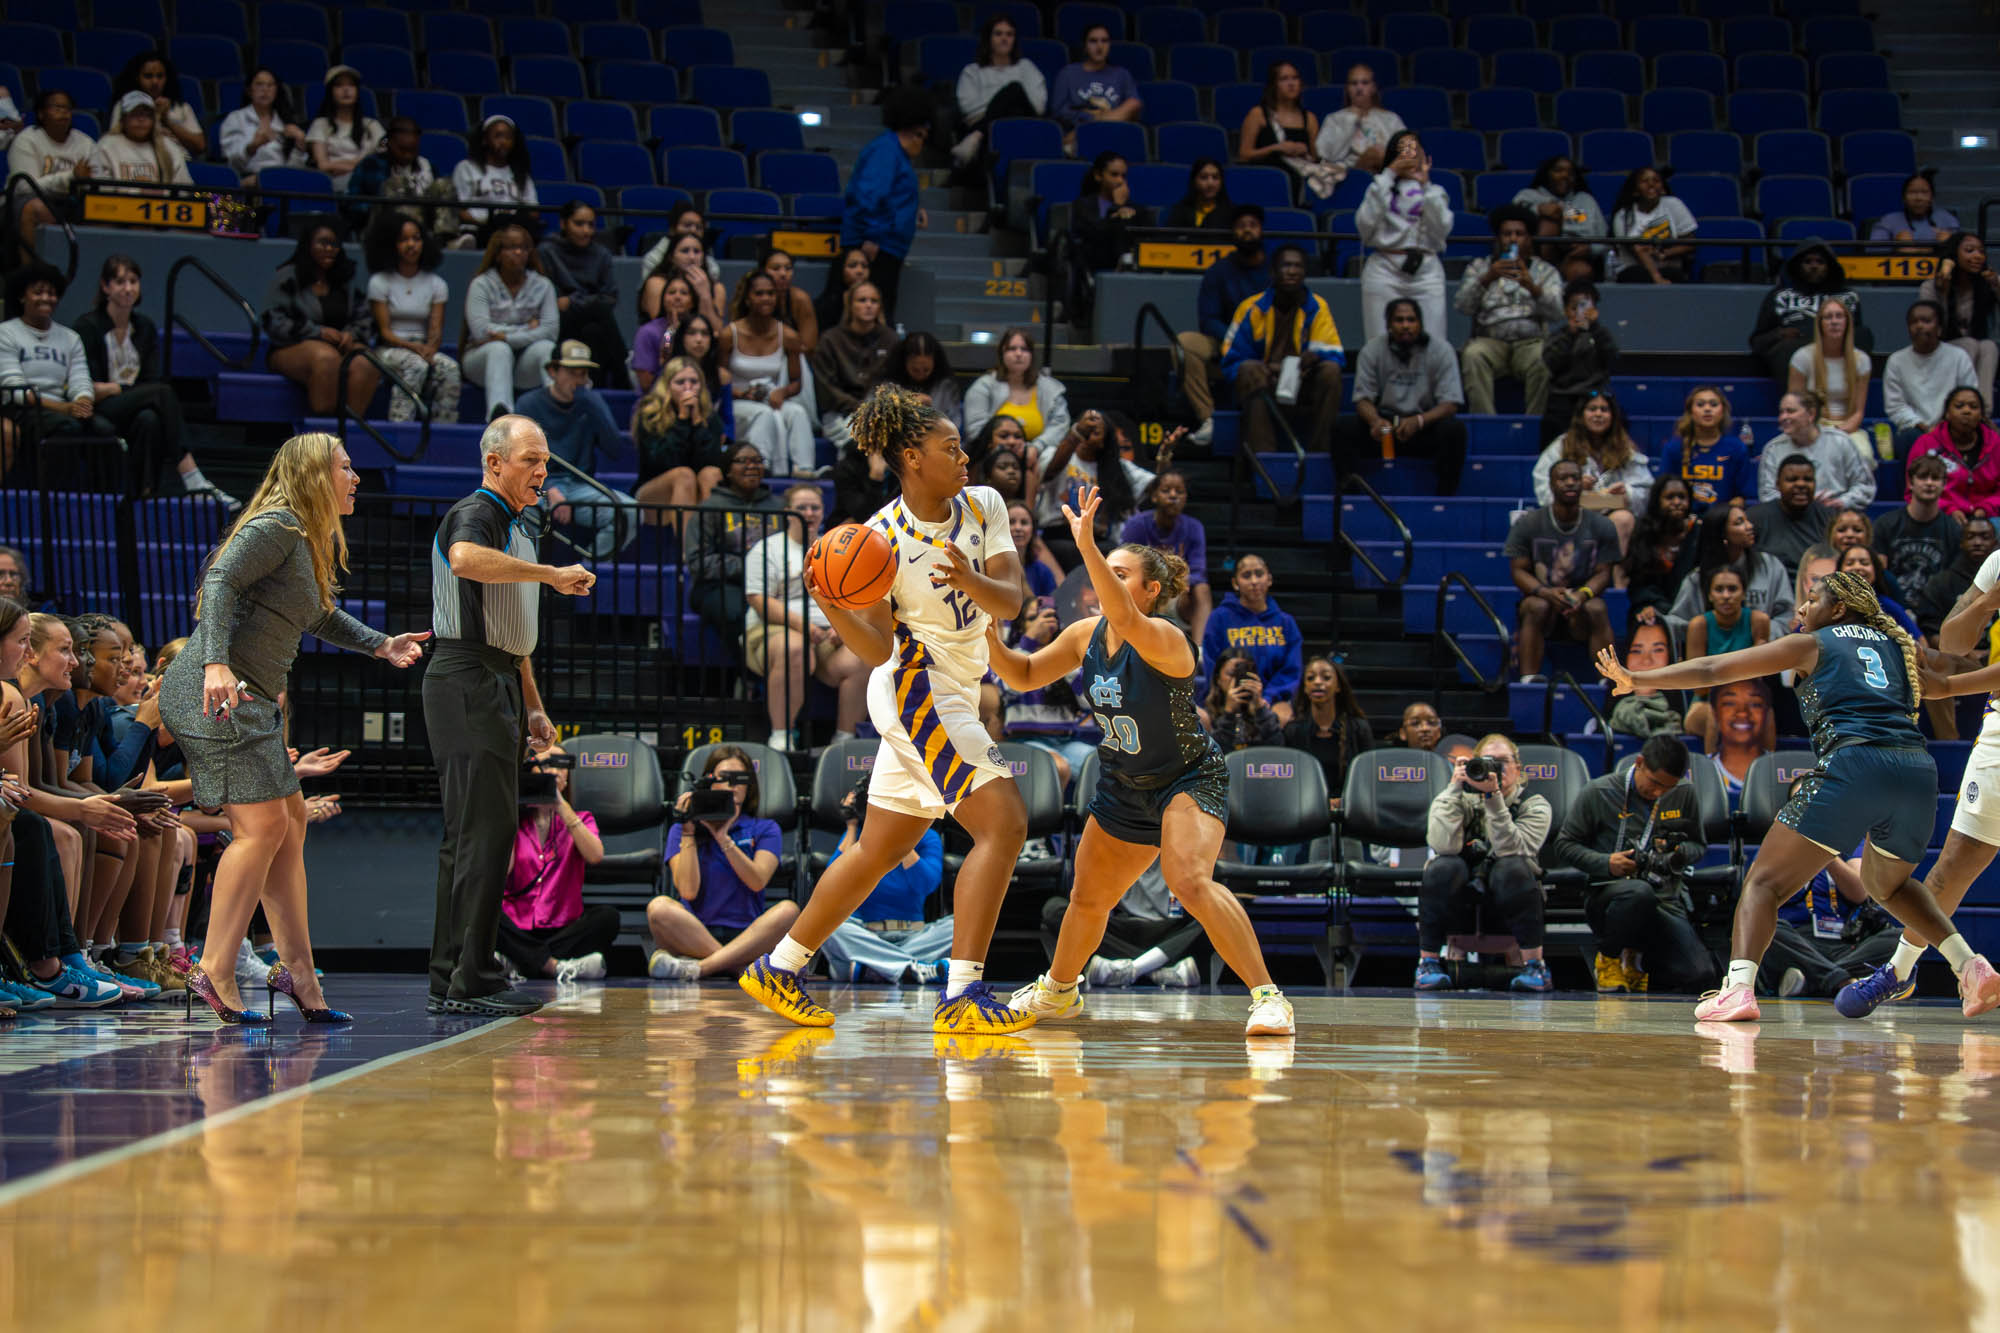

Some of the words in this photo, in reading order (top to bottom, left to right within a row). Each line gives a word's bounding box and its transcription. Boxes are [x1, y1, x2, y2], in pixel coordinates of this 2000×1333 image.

[137, 202, 193, 223] 118
[1877, 259, 1934, 277] 119
[984, 280, 1027, 297] 225
[19, 346, 67, 367] LSU
[1682, 464, 1724, 480] LSU
[834, 527, 858, 556] LSU
[943, 589, 977, 630] 12
[1857, 646, 1890, 689] 3
[1094, 711, 1142, 755] 20
[580, 752, 628, 769] LSU
[847, 756, 876, 771] LS
[1246, 763, 1294, 779] LSU
[1378, 766, 1426, 782] LSU
[1523, 764, 1558, 780] SU
[1777, 768, 1815, 784] LS
[1660, 809, 1681, 820] LSU
